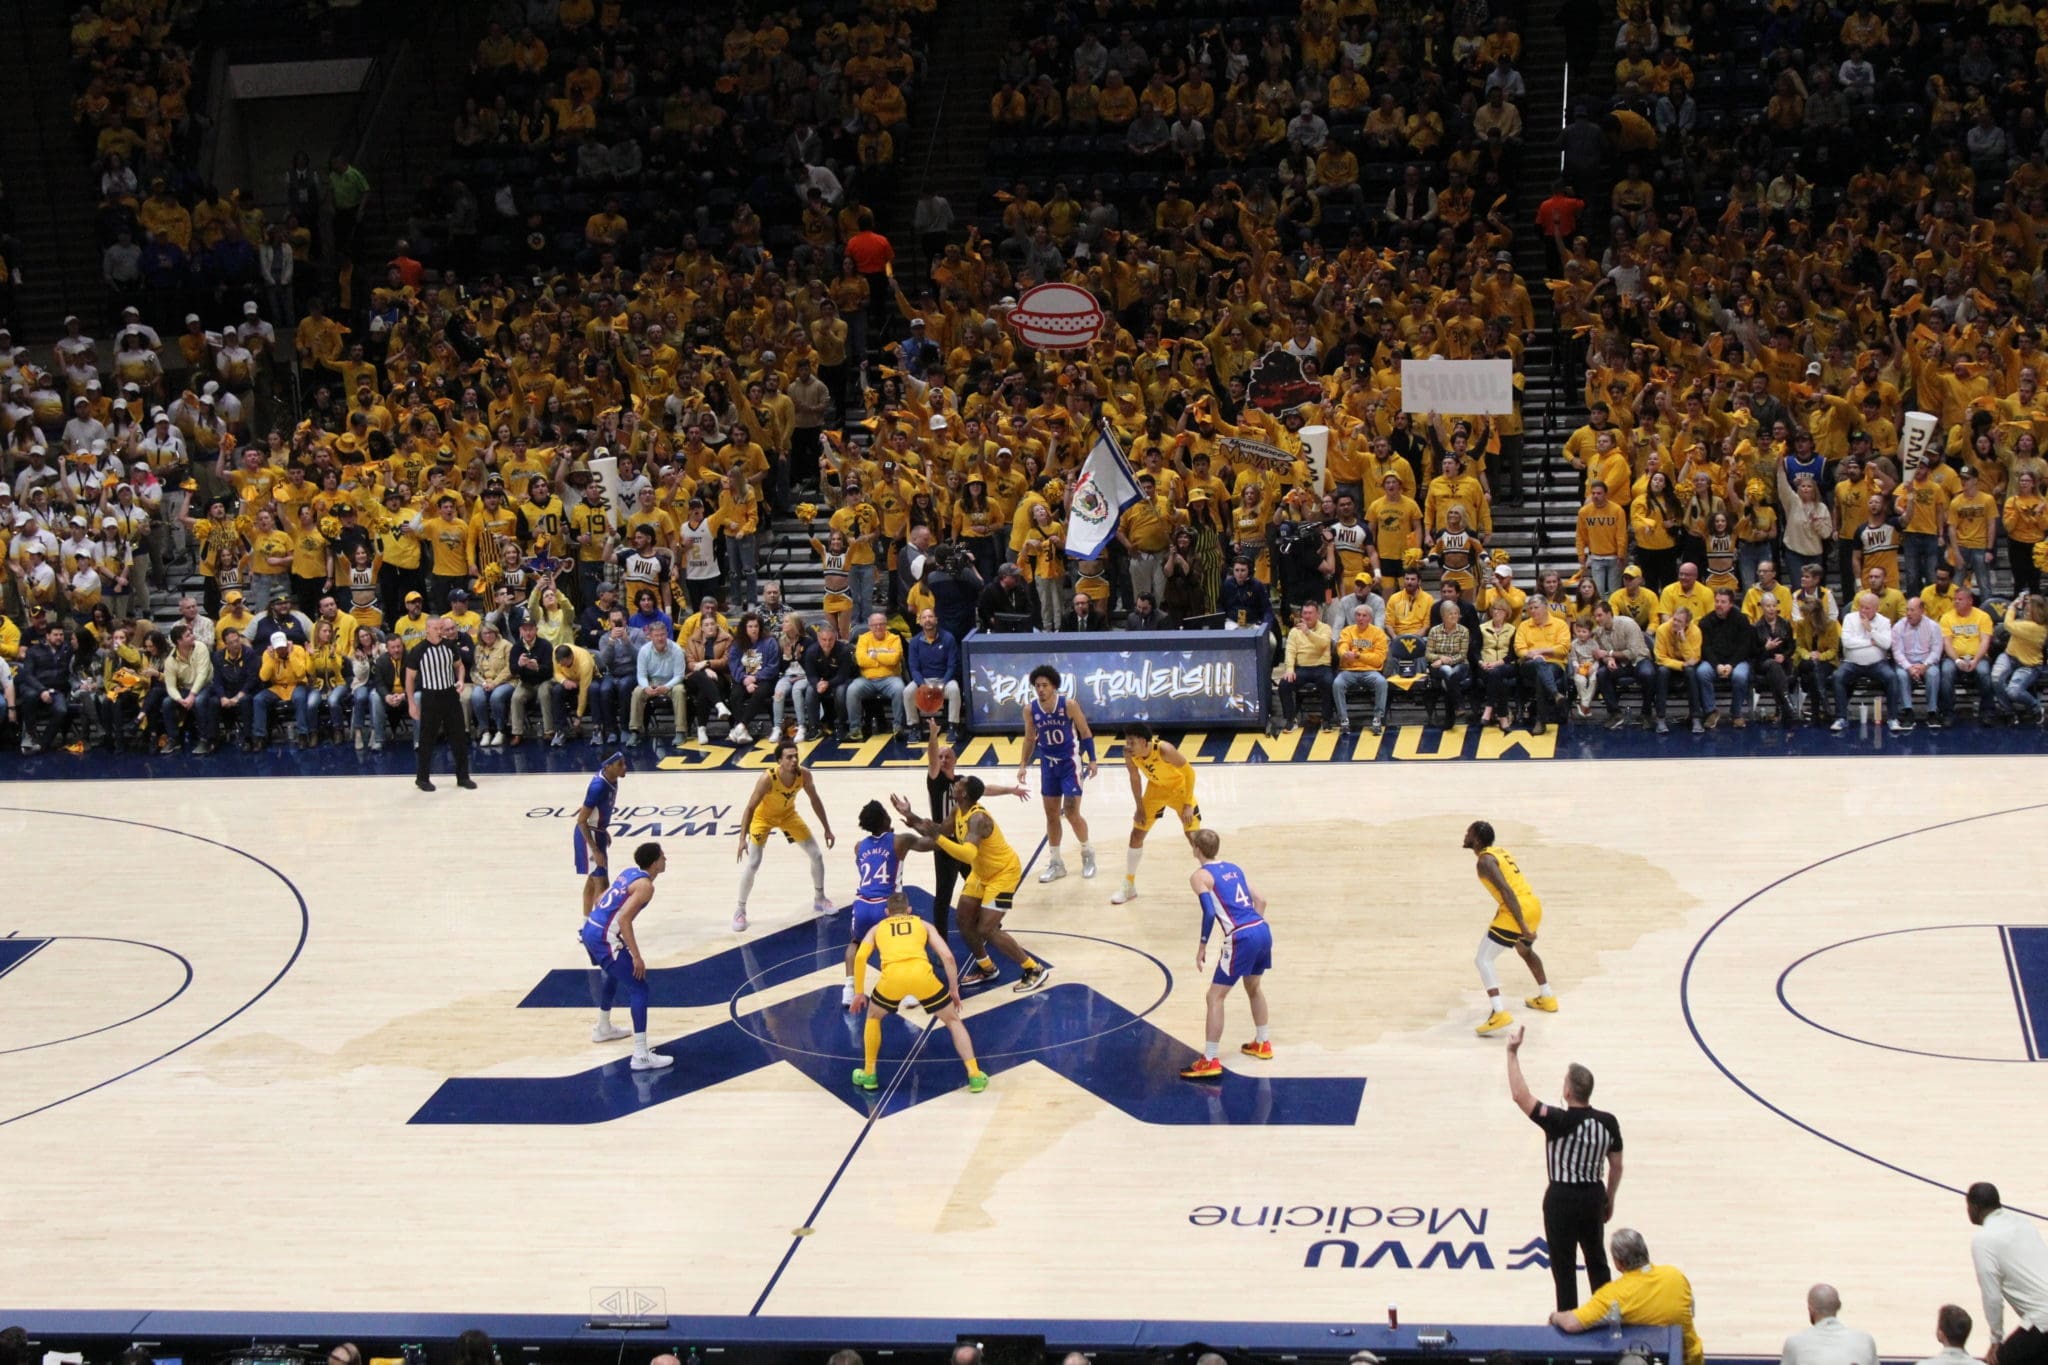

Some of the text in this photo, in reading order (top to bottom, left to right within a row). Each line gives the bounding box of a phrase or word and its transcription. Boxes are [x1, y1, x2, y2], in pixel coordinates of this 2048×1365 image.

[1229, 438, 1288, 459] Mountaineer
[1905, 428, 1926, 471] WVU
[587, 513, 605, 535] 19
[1586, 517, 1616, 527] WVU
[1338, 528, 1358, 543] WVU
[1447, 536, 1463, 548] WVU
[1867, 531, 1886, 546] WVU
[1712, 537, 1730, 551] WVU
[634, 560, 652, 576] WVU
[826, 556, 842, 569] WVU
[220, 570, 238, 584] WVU
[353, 571, 370, 585] WVU
[1083, 659, 1235, 706] TOWELS!!!
[1036, 720, 1066, 729] KANSAS
[1044, 729, 1065, 746] 10
[861, 861, 890, 887] 24
[1235, 882, 1251, 908] 4
[890, 921, 912, 937] 10
[1188, 1205, 1489, 1235] Medicine
[1303, 1239, 1496, 1270] WVU
